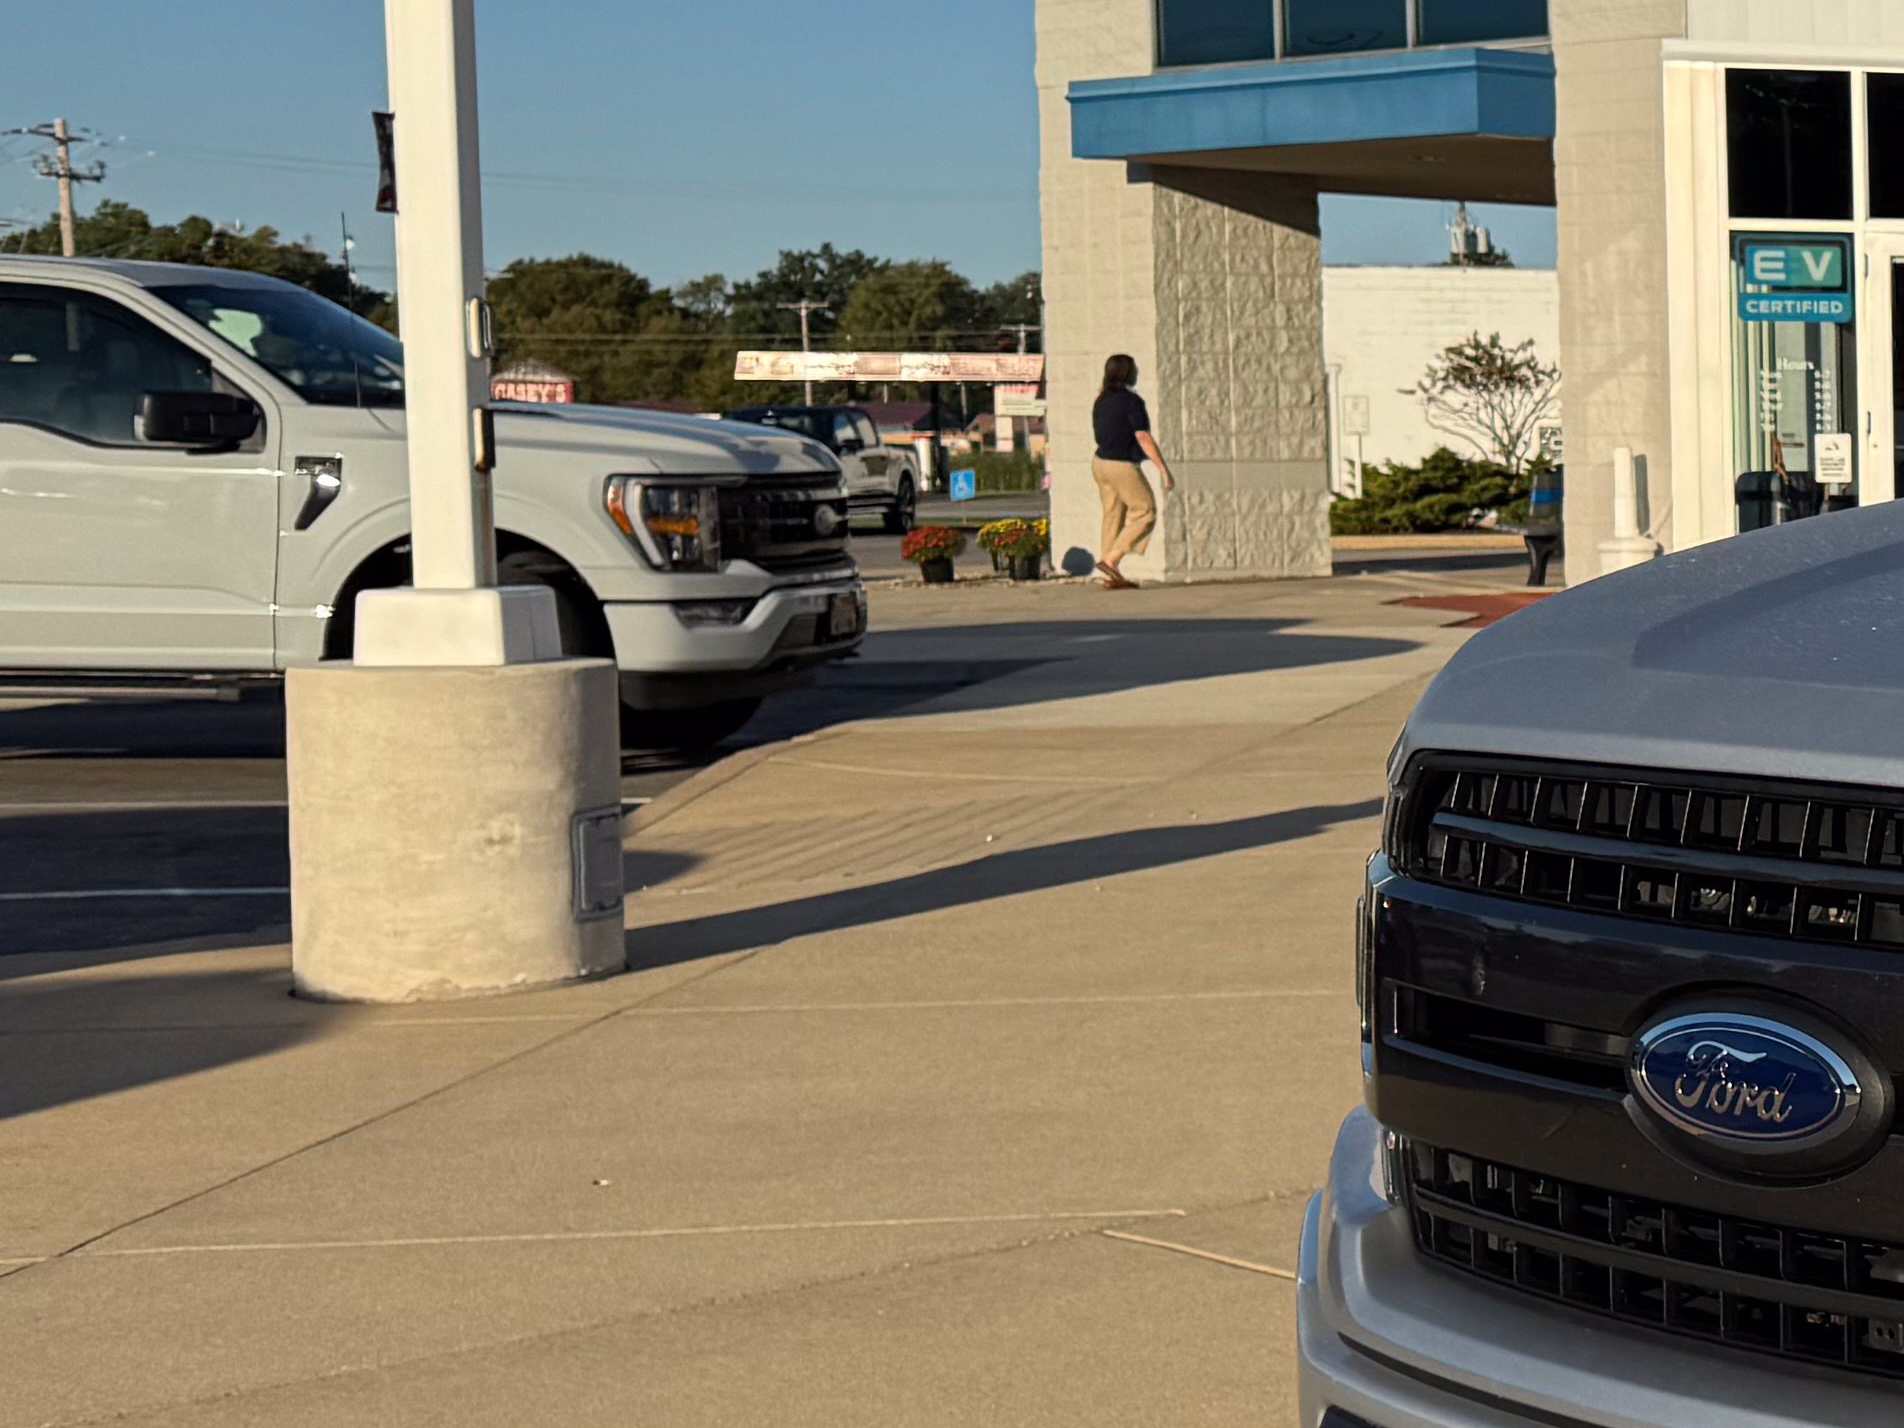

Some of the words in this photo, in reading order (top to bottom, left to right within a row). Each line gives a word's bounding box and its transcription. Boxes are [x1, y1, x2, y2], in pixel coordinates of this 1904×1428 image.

[1753, 250, 1833, 281] EV
[1745, 300, 1844, 314] CERTIFIED
[1674, 1039, 1797, 1123] Ford
